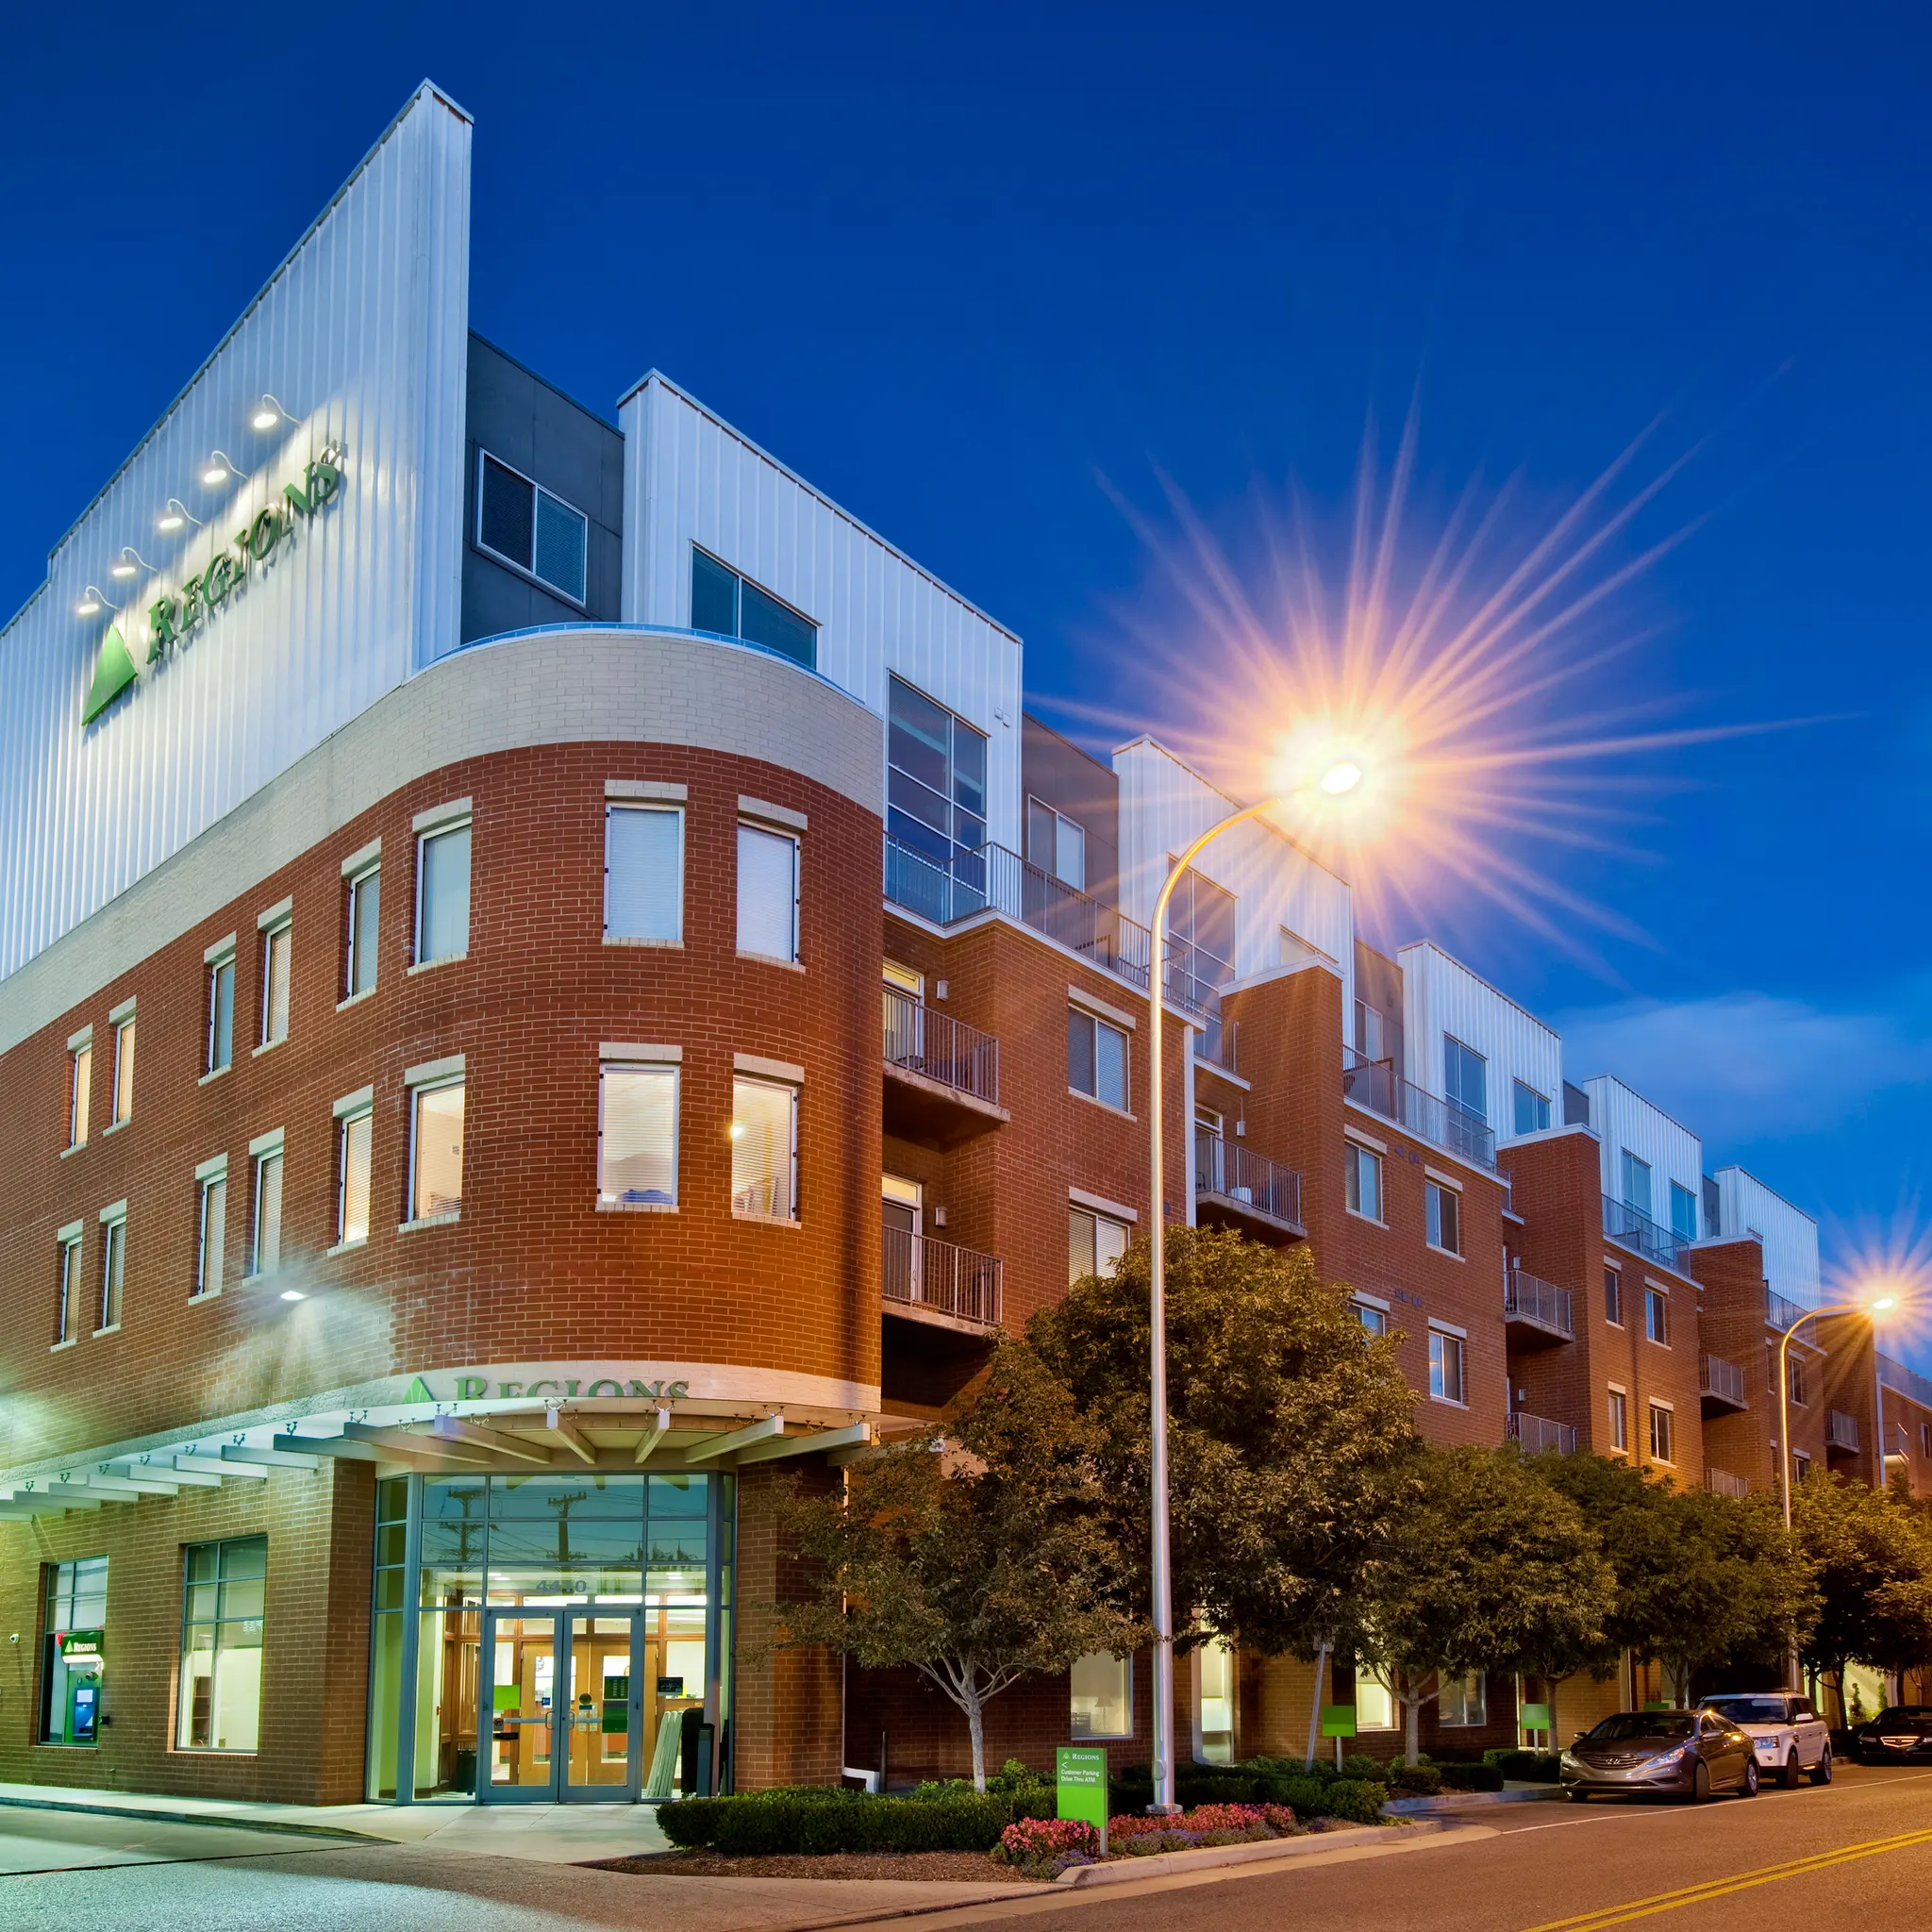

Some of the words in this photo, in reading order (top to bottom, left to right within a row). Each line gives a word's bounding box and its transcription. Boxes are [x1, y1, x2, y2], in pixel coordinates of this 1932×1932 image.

[146, 440, 341, 665] REGIONS
[453, 1375, 690, 1401] REGIONS
[536, 1579, 587, 1592] 4410
[74, 1642, 96, 1653] REGIONS
